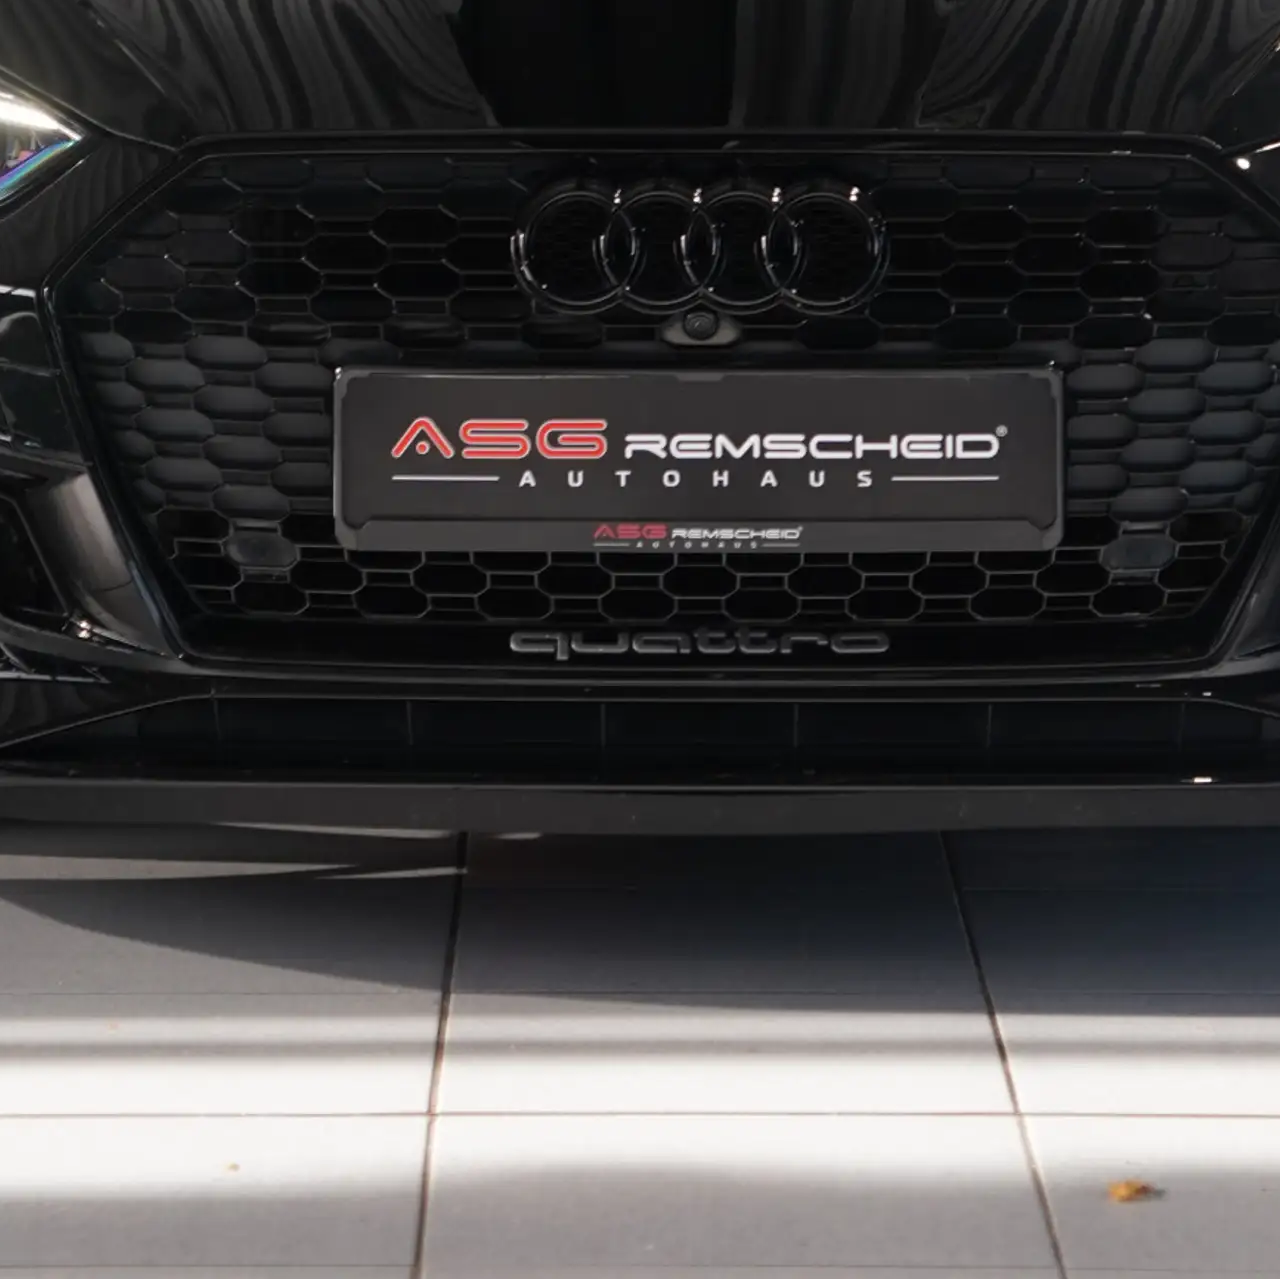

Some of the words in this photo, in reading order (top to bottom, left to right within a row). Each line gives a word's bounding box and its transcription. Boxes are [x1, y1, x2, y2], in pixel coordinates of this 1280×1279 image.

[391, 416, 608, 460] ASG
[519, 470, 873, 488] AUTOHAUS
[593, 523, 668, 540] ASG
[509, 625, 891, 661] quattro
